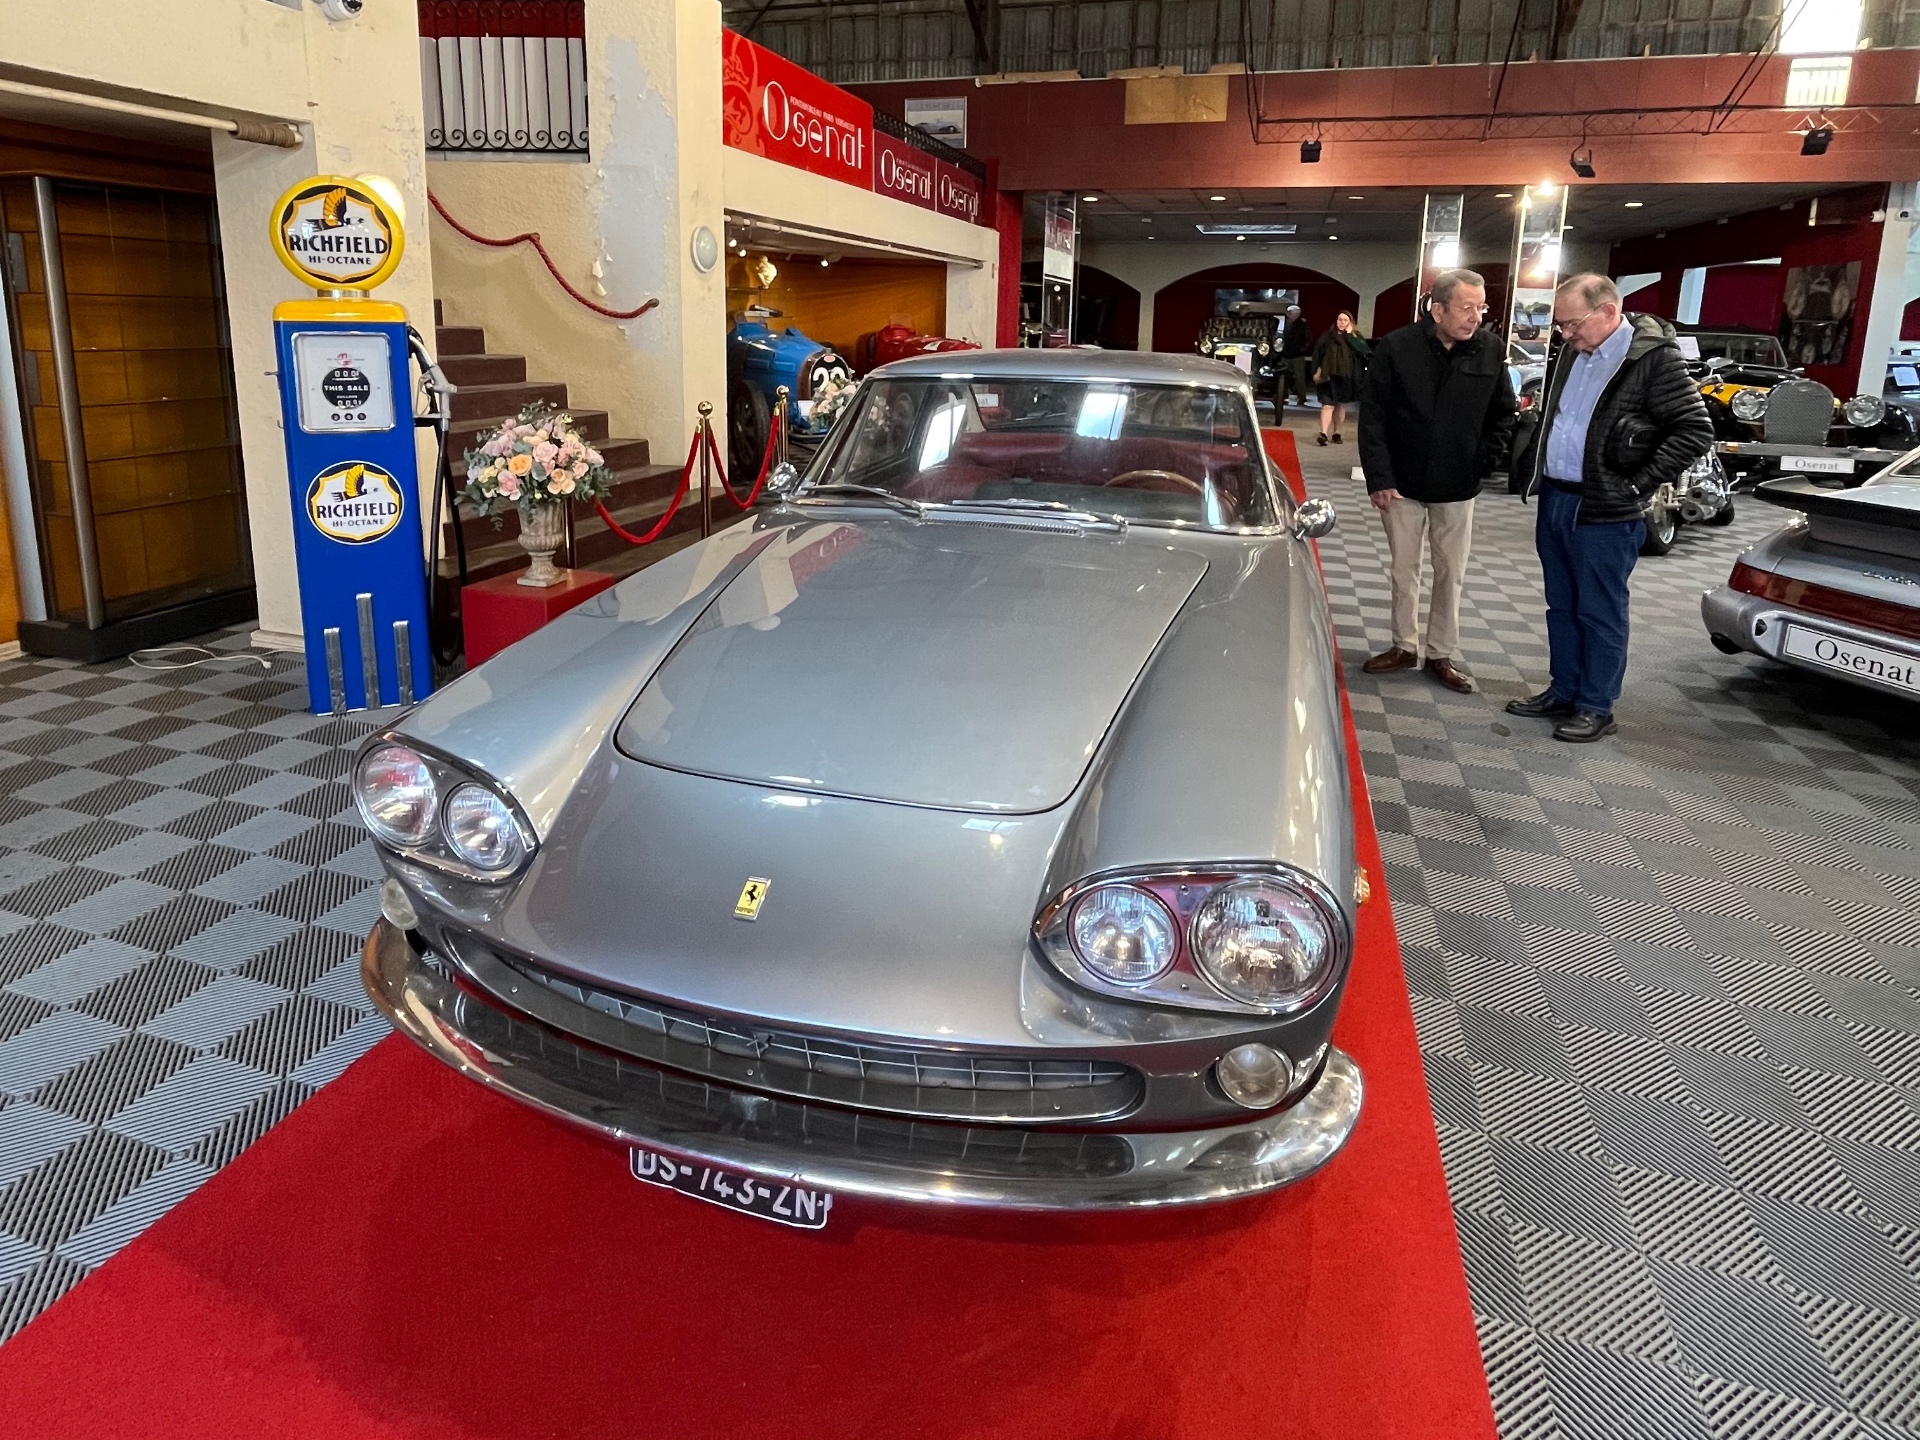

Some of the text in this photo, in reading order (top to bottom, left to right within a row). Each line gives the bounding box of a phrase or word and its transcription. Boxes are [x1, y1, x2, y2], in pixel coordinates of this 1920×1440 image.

[763, 81, 865, 170] Osenat
[881, 149, 932, 200] Osenat
[941, 174, 979, 217] Osenat
[290, 234, 388, 254] RICHFIELD
[308, 255, 371, 265] HI-OCTANE
[1794, 459, 1840, 471] Osenat
[316, 502, 398, 519] RICHFIELD
[332, 518, 384, 527] HI-OCTANE
[1814, 639, 1917, 685] Osenat
